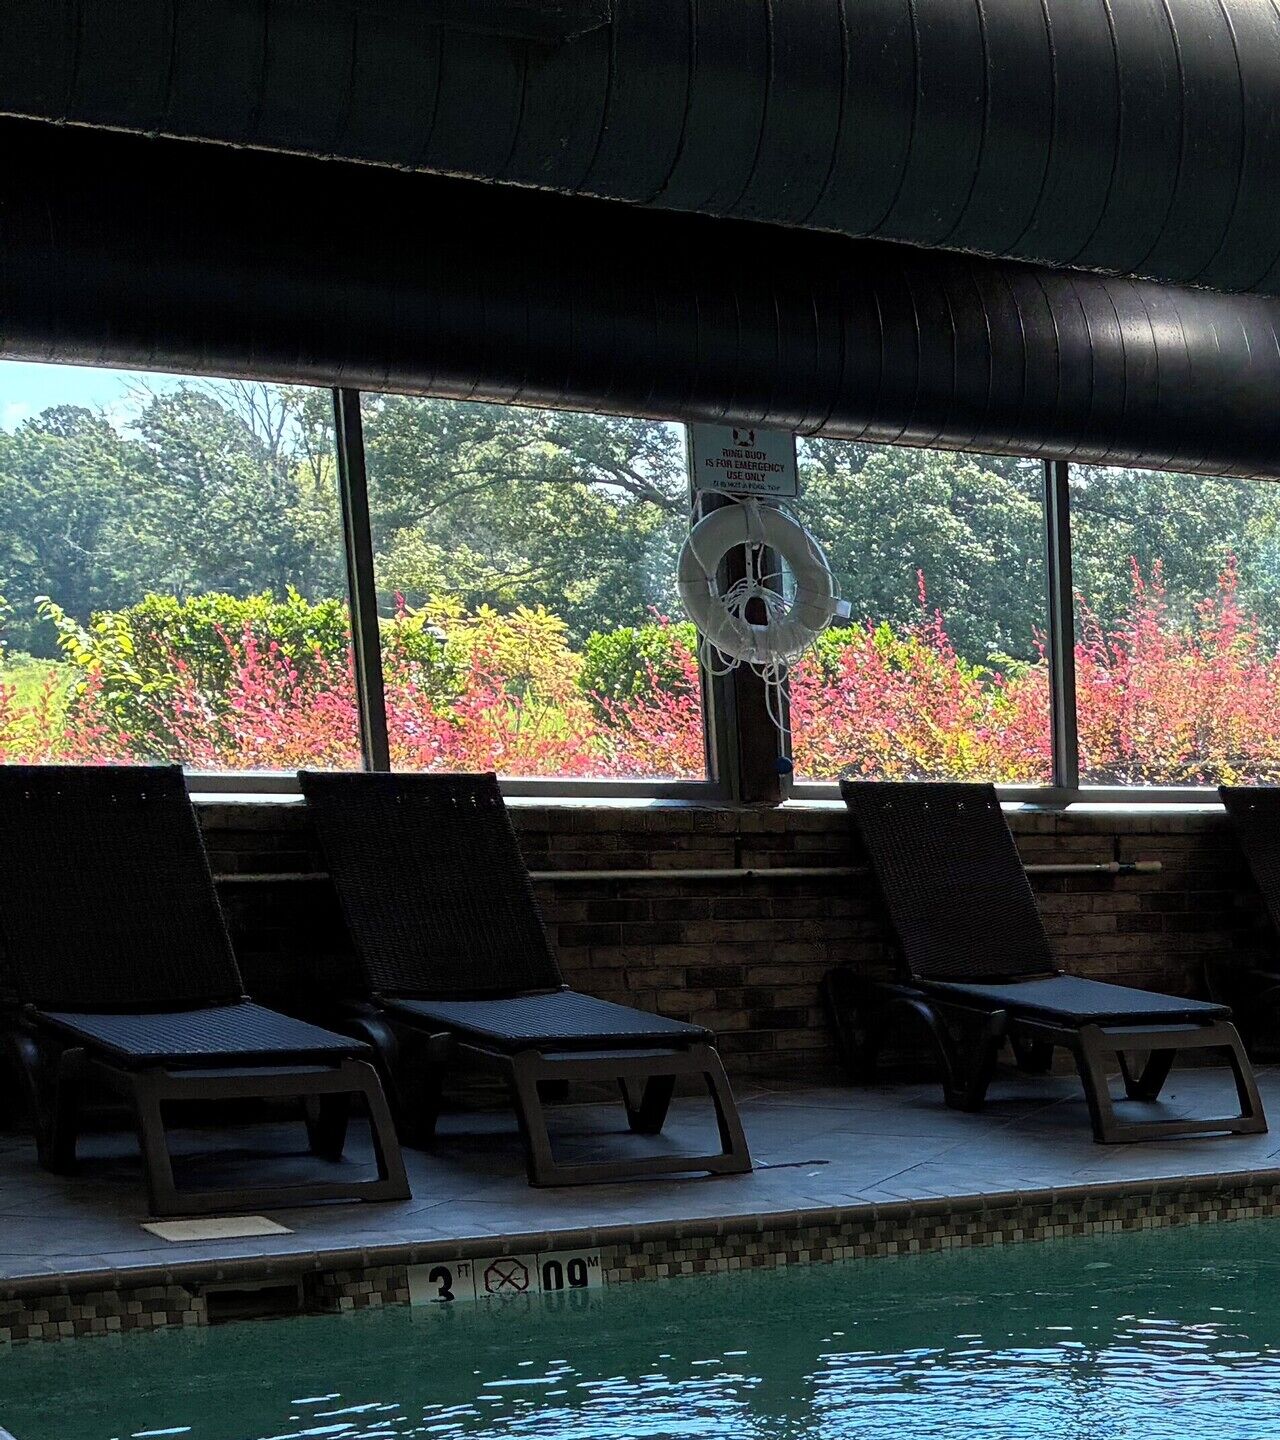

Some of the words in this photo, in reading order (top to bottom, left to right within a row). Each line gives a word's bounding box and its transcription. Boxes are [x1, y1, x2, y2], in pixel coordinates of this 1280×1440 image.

[722, 448, 742, 458] RING
[745, 450, 767, 460] BUOY
[705, 459, 713, 467] IS
[716, 459, 732, 468] FOR
[735, 461, 785, 473] EMERGENCY
[726, 471, 742, 480] USE
[745, 472, 766, 482] ONLY
[428, 1265, 455, 1302] 3
[457, 1263, 471, 1278] FT
[588, 1256, 599, 1267] M
